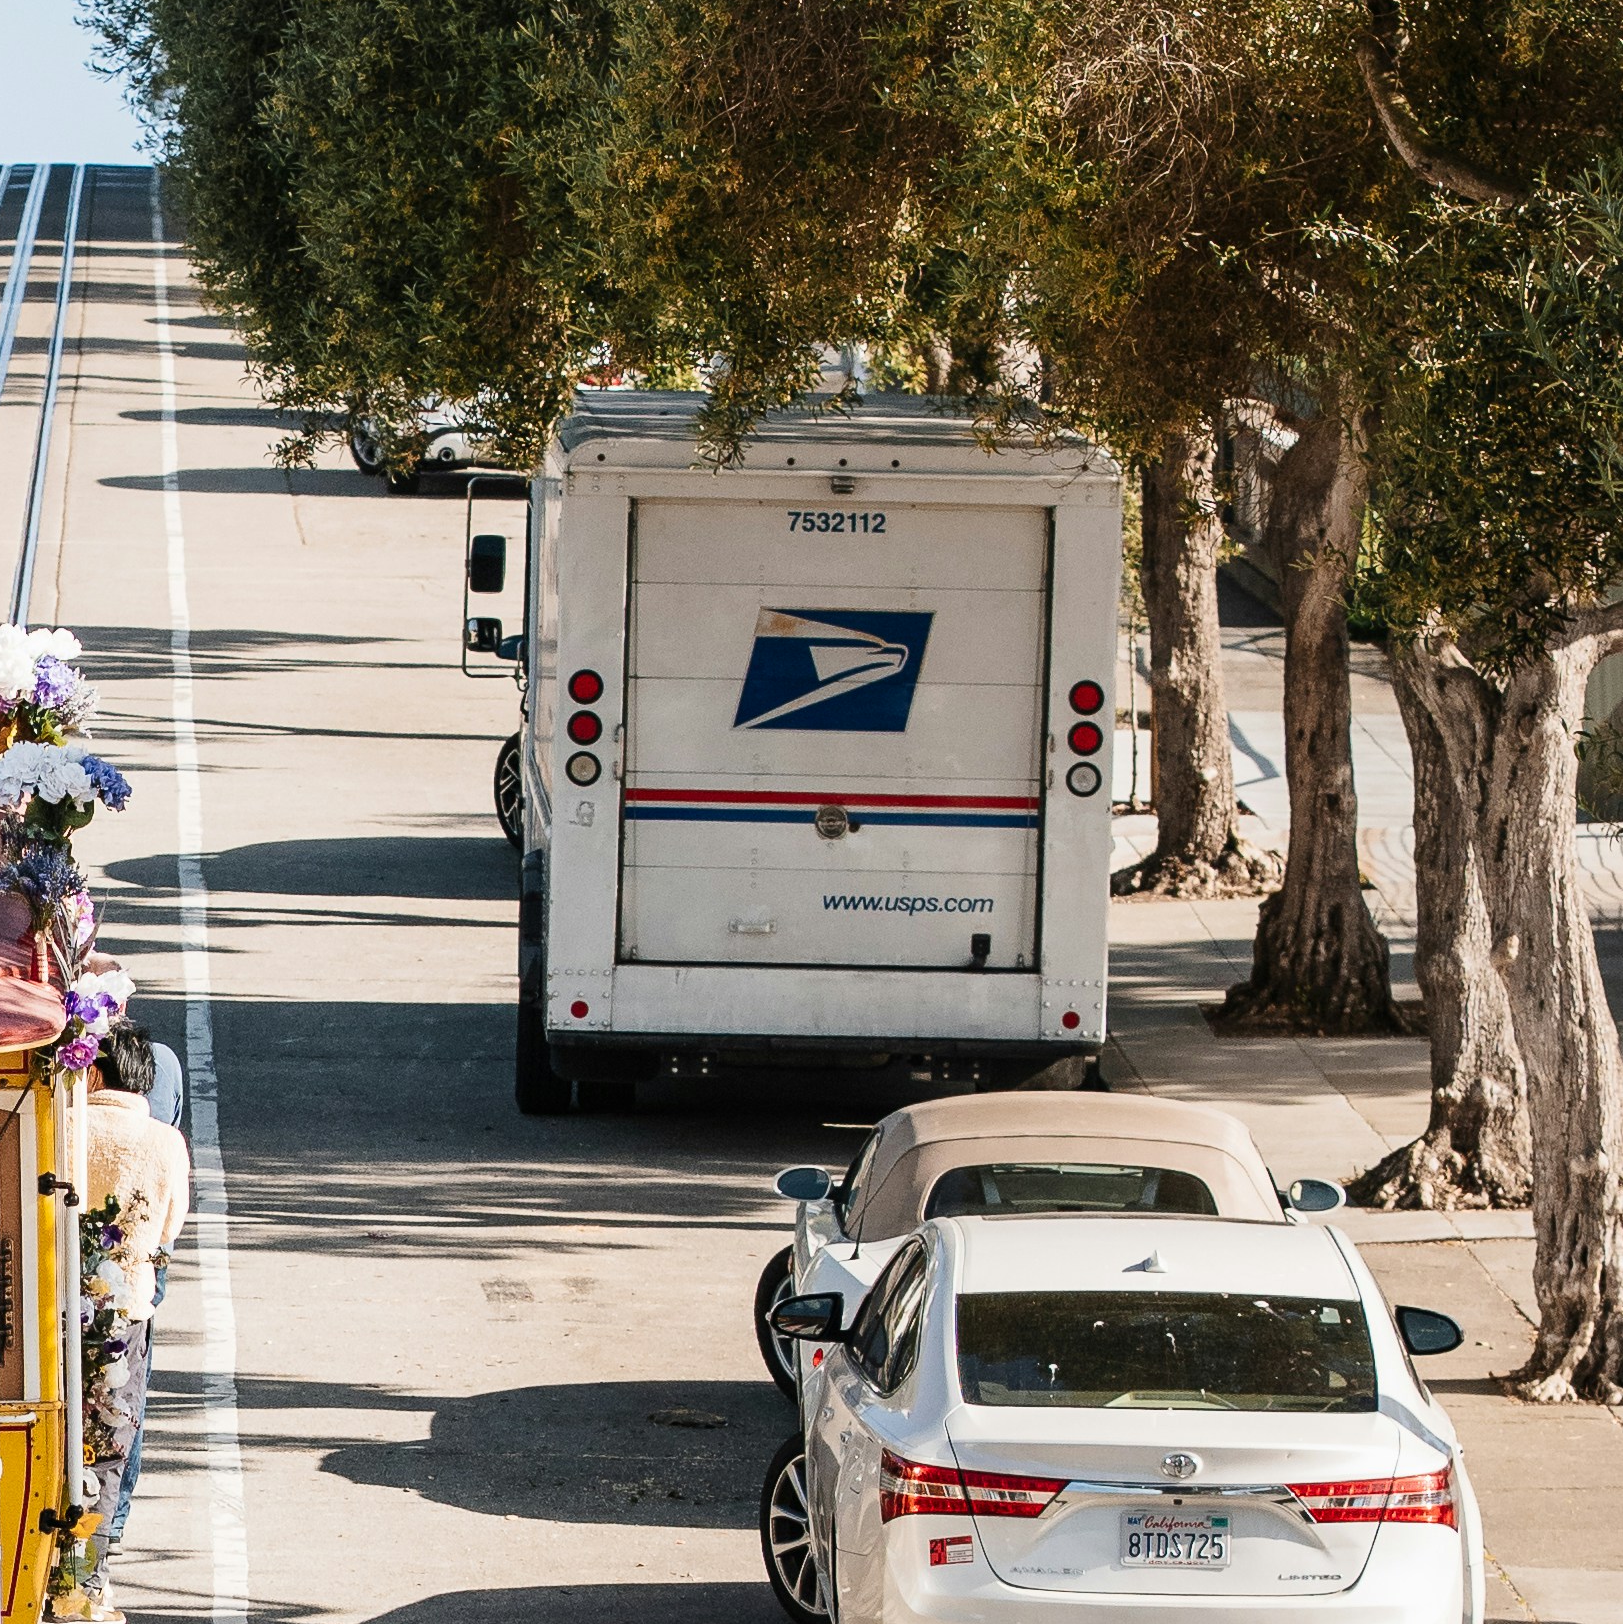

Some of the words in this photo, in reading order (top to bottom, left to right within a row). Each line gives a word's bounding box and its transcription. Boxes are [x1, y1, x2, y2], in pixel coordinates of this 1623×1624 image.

[787, 511, 886, 533] 7532112
[823, 895, 994, 916] www.usps.com
[1144, 1516, 1212, 1533] California
[1128, 1532, 1224, 1559] 8TDS725
